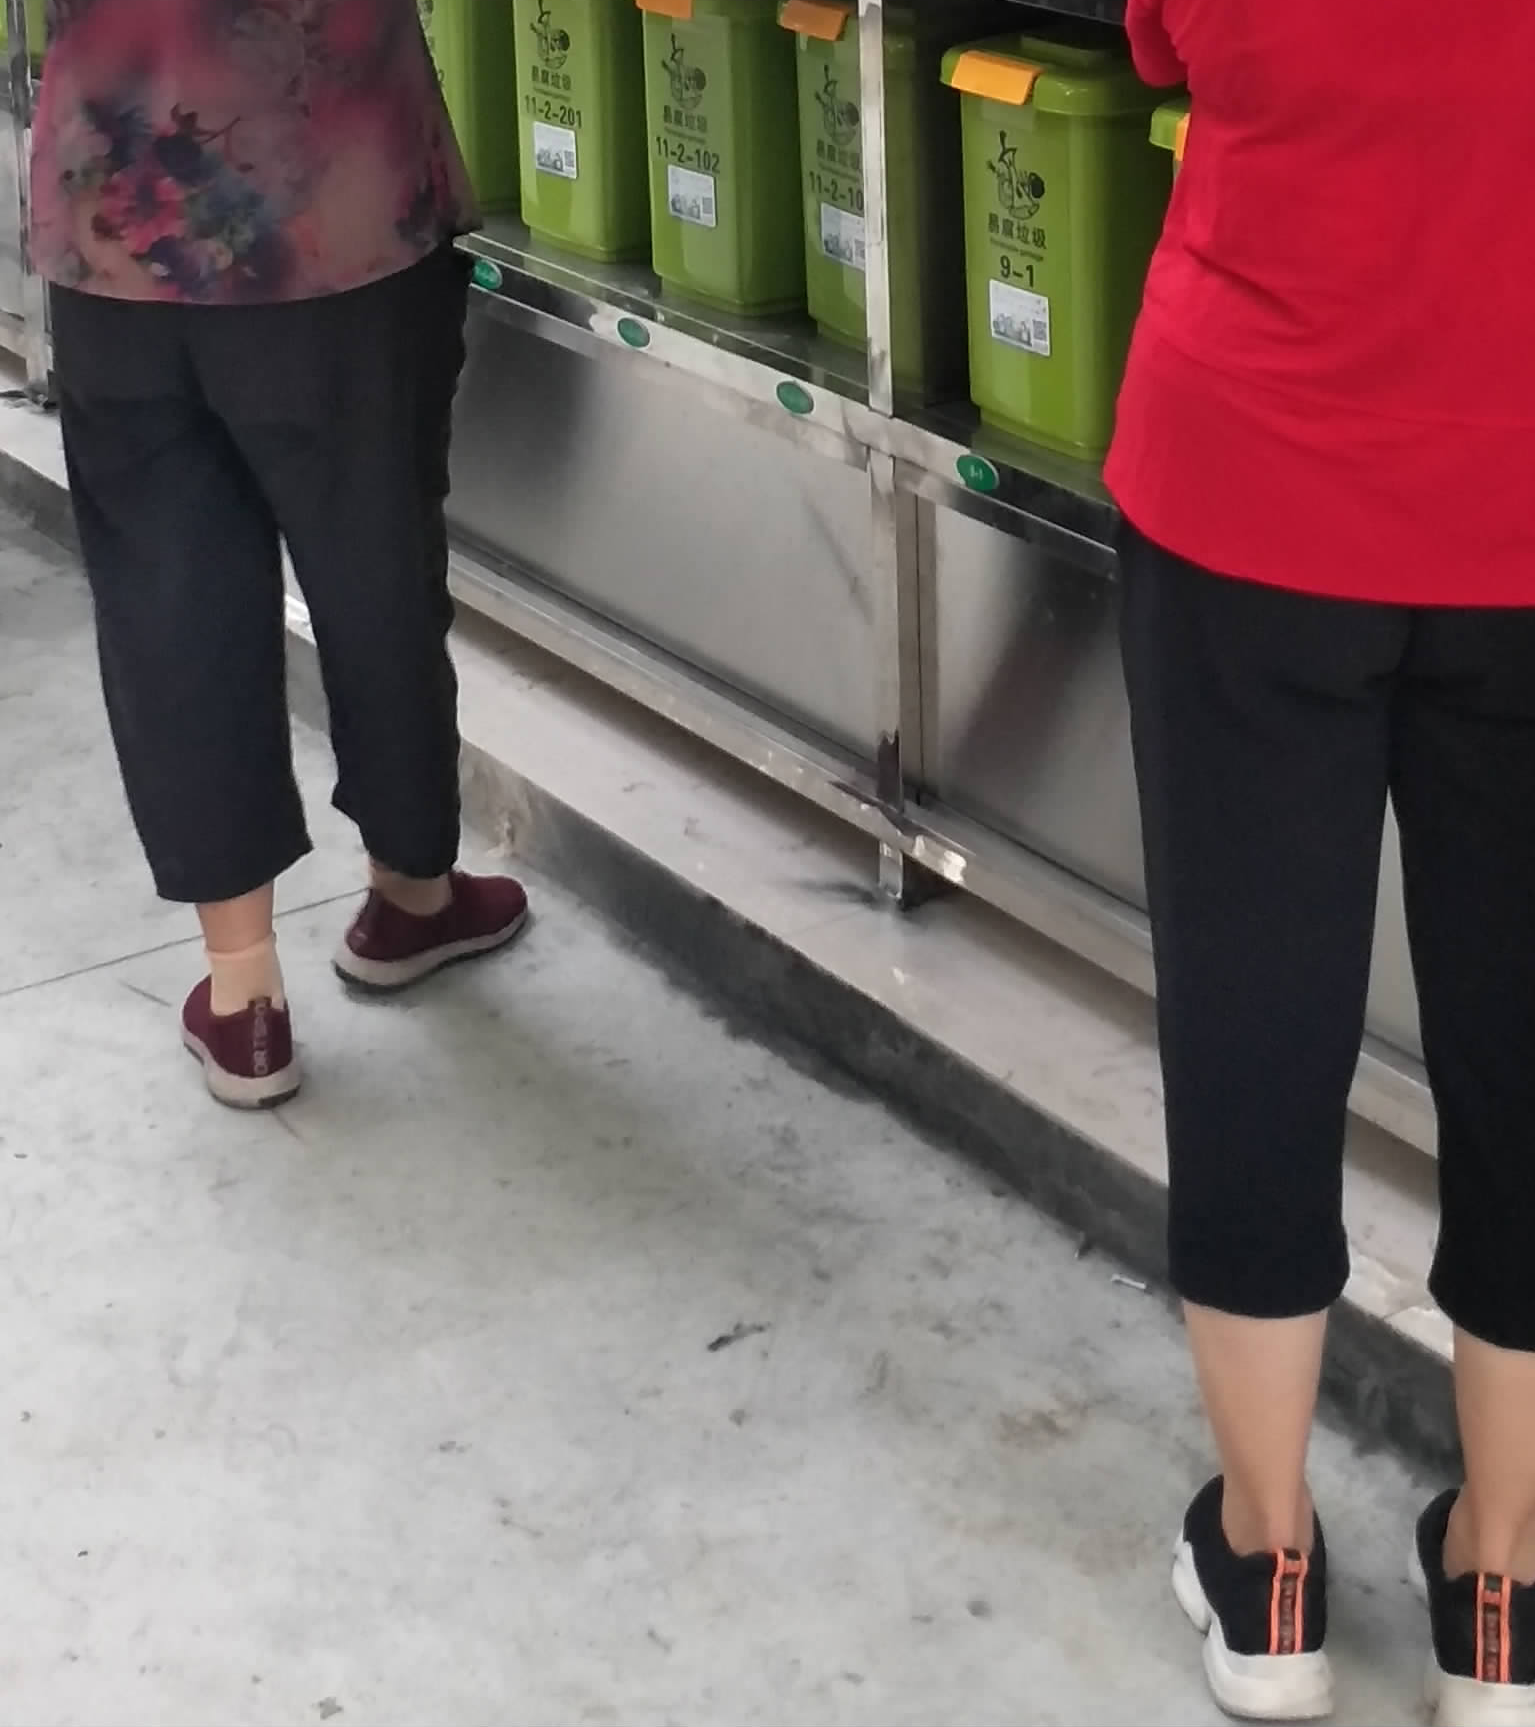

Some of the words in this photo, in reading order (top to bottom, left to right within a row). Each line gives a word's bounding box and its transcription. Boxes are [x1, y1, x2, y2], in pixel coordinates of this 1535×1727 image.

[525, 95, 582, 128] 11-2-201
[656, 136, 720, 173] 11-2-102
[809, 171, 864, 210] 11-2-10
[989, 212, 1046, 249] 易腐垃圾
[1000, 255, 1033, 288] 9-1
